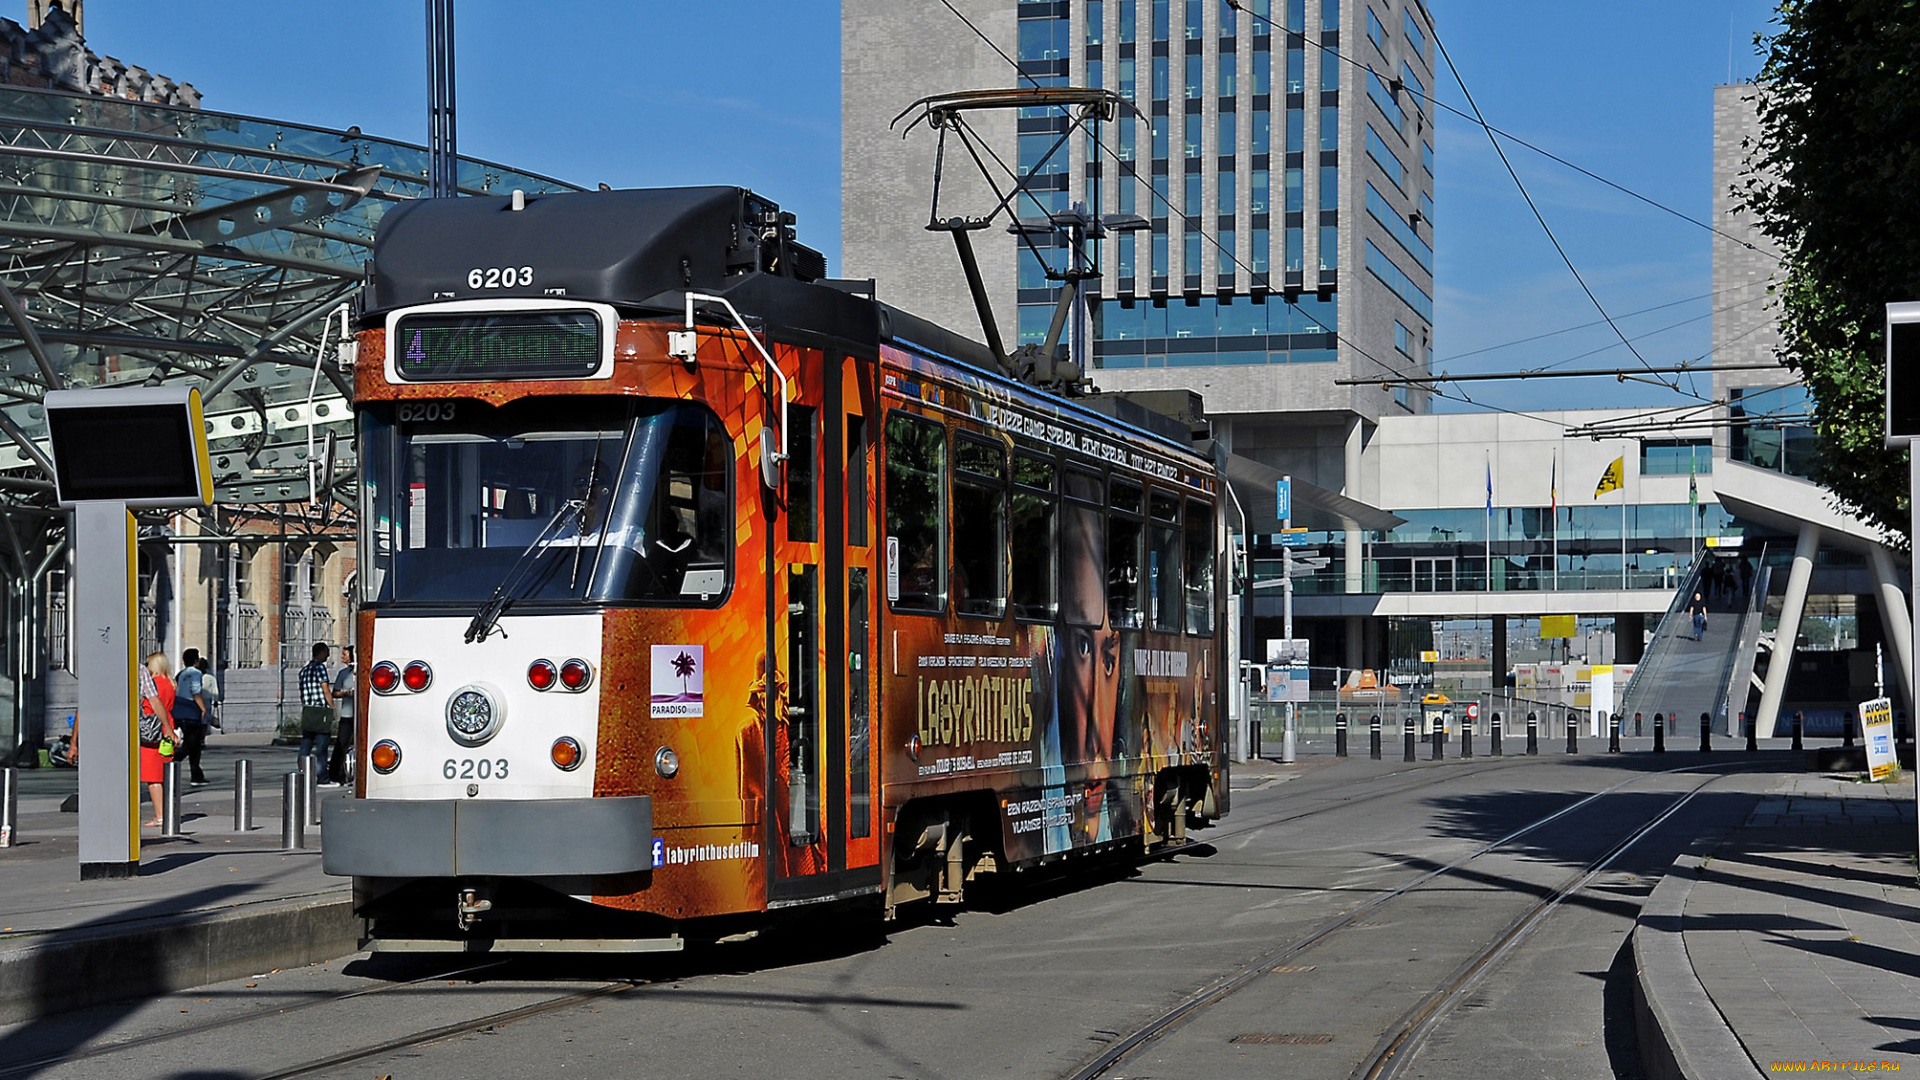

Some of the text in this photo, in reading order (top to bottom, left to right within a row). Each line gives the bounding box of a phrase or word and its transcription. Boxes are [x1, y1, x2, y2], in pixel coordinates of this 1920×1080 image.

[468, 266, 534, 289] 6203
[406, 330, 426, 364] 4
[400, 403, 456, 421] 6203
[652, 705, 687, 715] PARADISO
[918, 675, 1032, 748] LABYRINTHUS
[1865, 701, 1889, 714] AVOND
[1866, 712, 1890, 726] MARKT
[443, 758, 509, 780] 6203
[666, 843, 759, 866] labyrinthusdefilm
